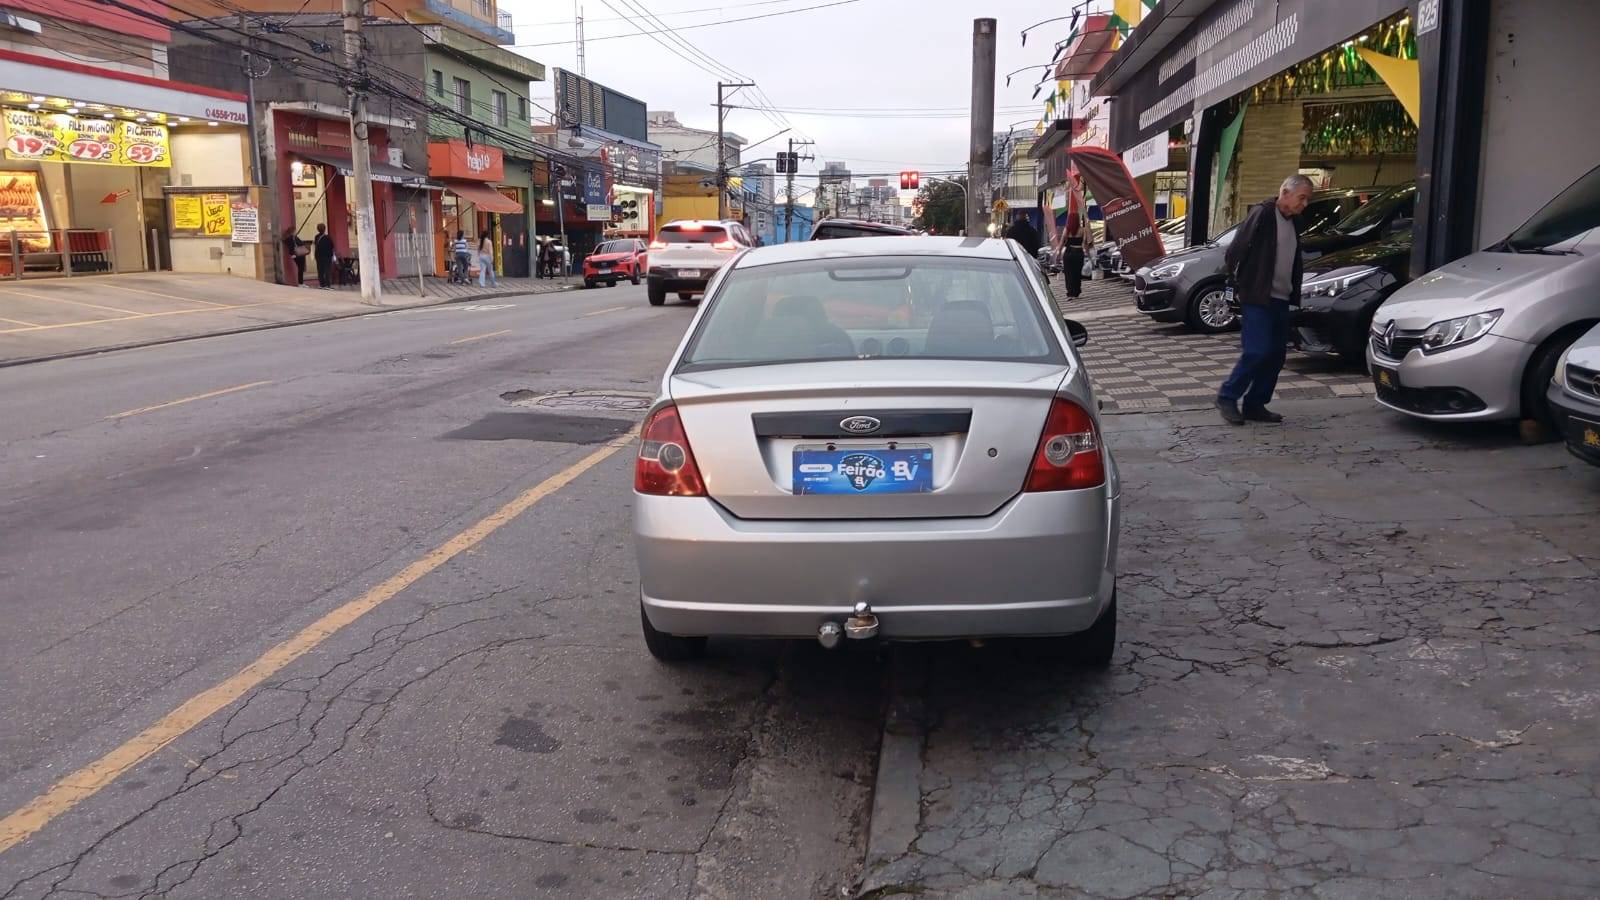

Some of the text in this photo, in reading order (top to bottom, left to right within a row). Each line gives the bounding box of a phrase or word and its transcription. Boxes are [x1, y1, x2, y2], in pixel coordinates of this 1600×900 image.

[1419, 1, 1437, 30] 625
[7, 112, 42, 127] COSTELA
[1118, 233, 1138, 250] Desde
[849, 419, 873, 430] Ford
[837, 463, 886, 480] Feirão
[894, 459, 919, 481] BV
